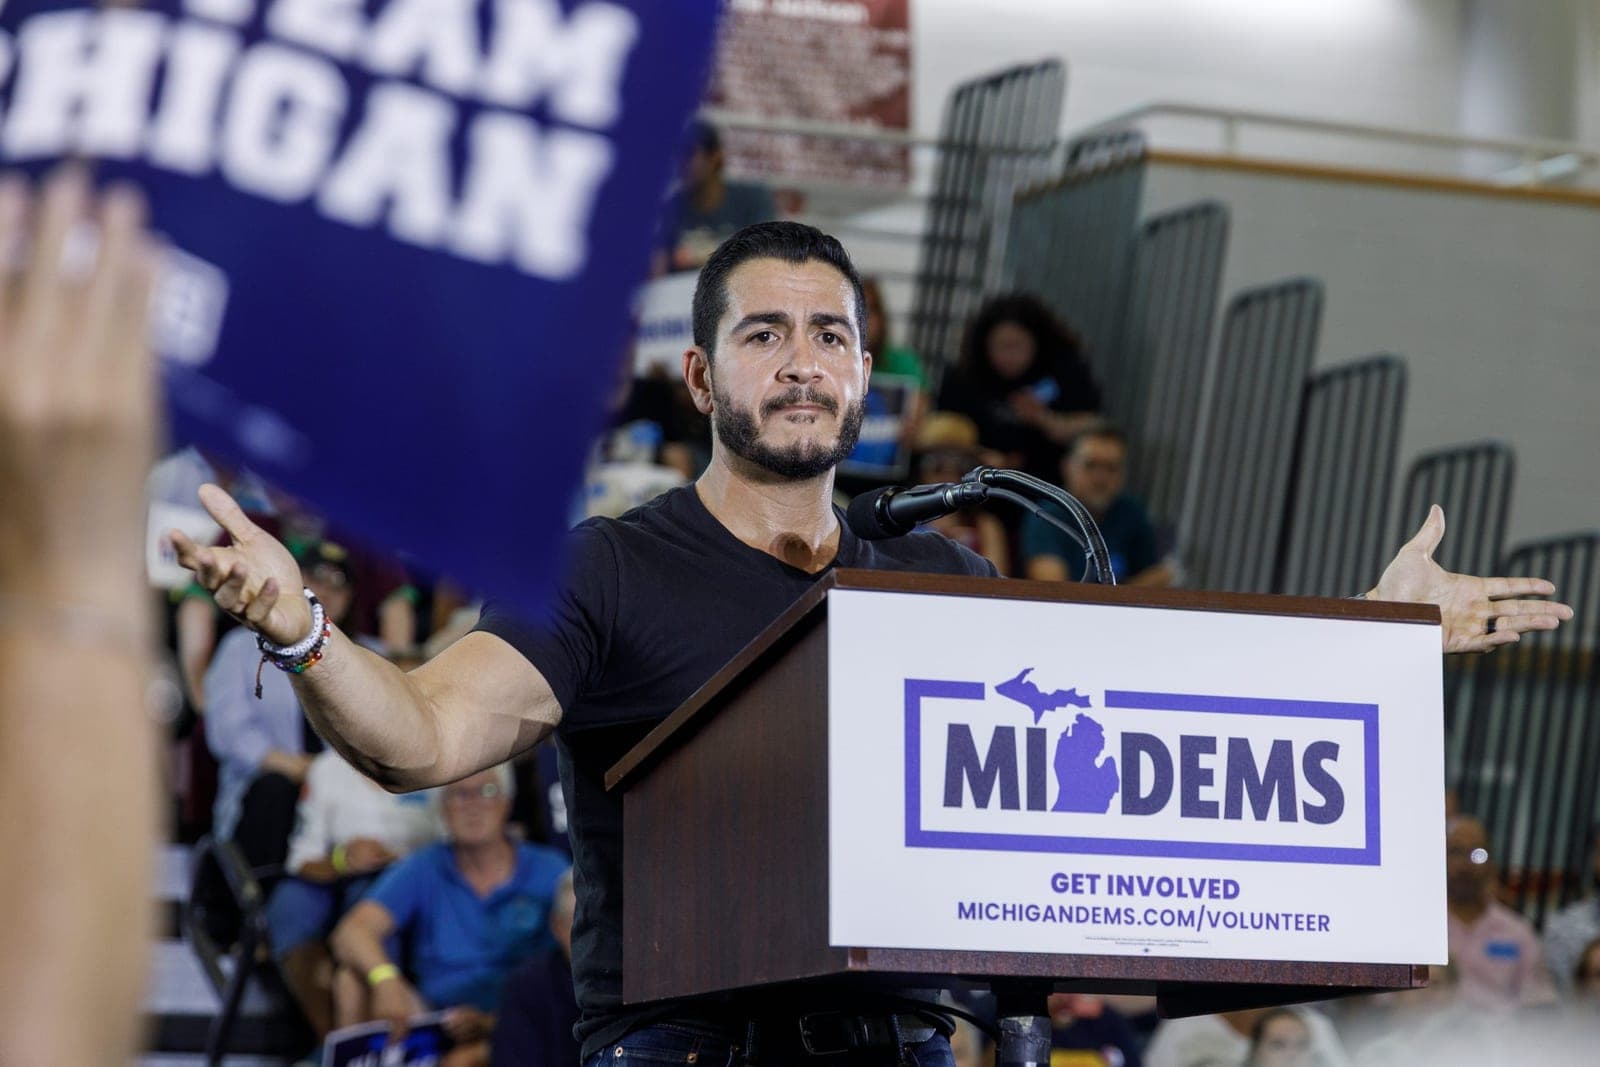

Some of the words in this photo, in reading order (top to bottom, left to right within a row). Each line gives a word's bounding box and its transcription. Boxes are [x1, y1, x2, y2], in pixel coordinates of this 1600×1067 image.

[184, 0, 637, 127] AM
[0, 6, 613, 279] HIGAN
[943, 722, 1048, 812] MI
[1120, 731, 1345, 825] DEMS
[957, 901, 1331, 932] MICHIGANDEMS.COM/VOLUNTEER
[1050, 872, 1102, 895] GET
[1107, 874, 1241, 900] INVOLVED
